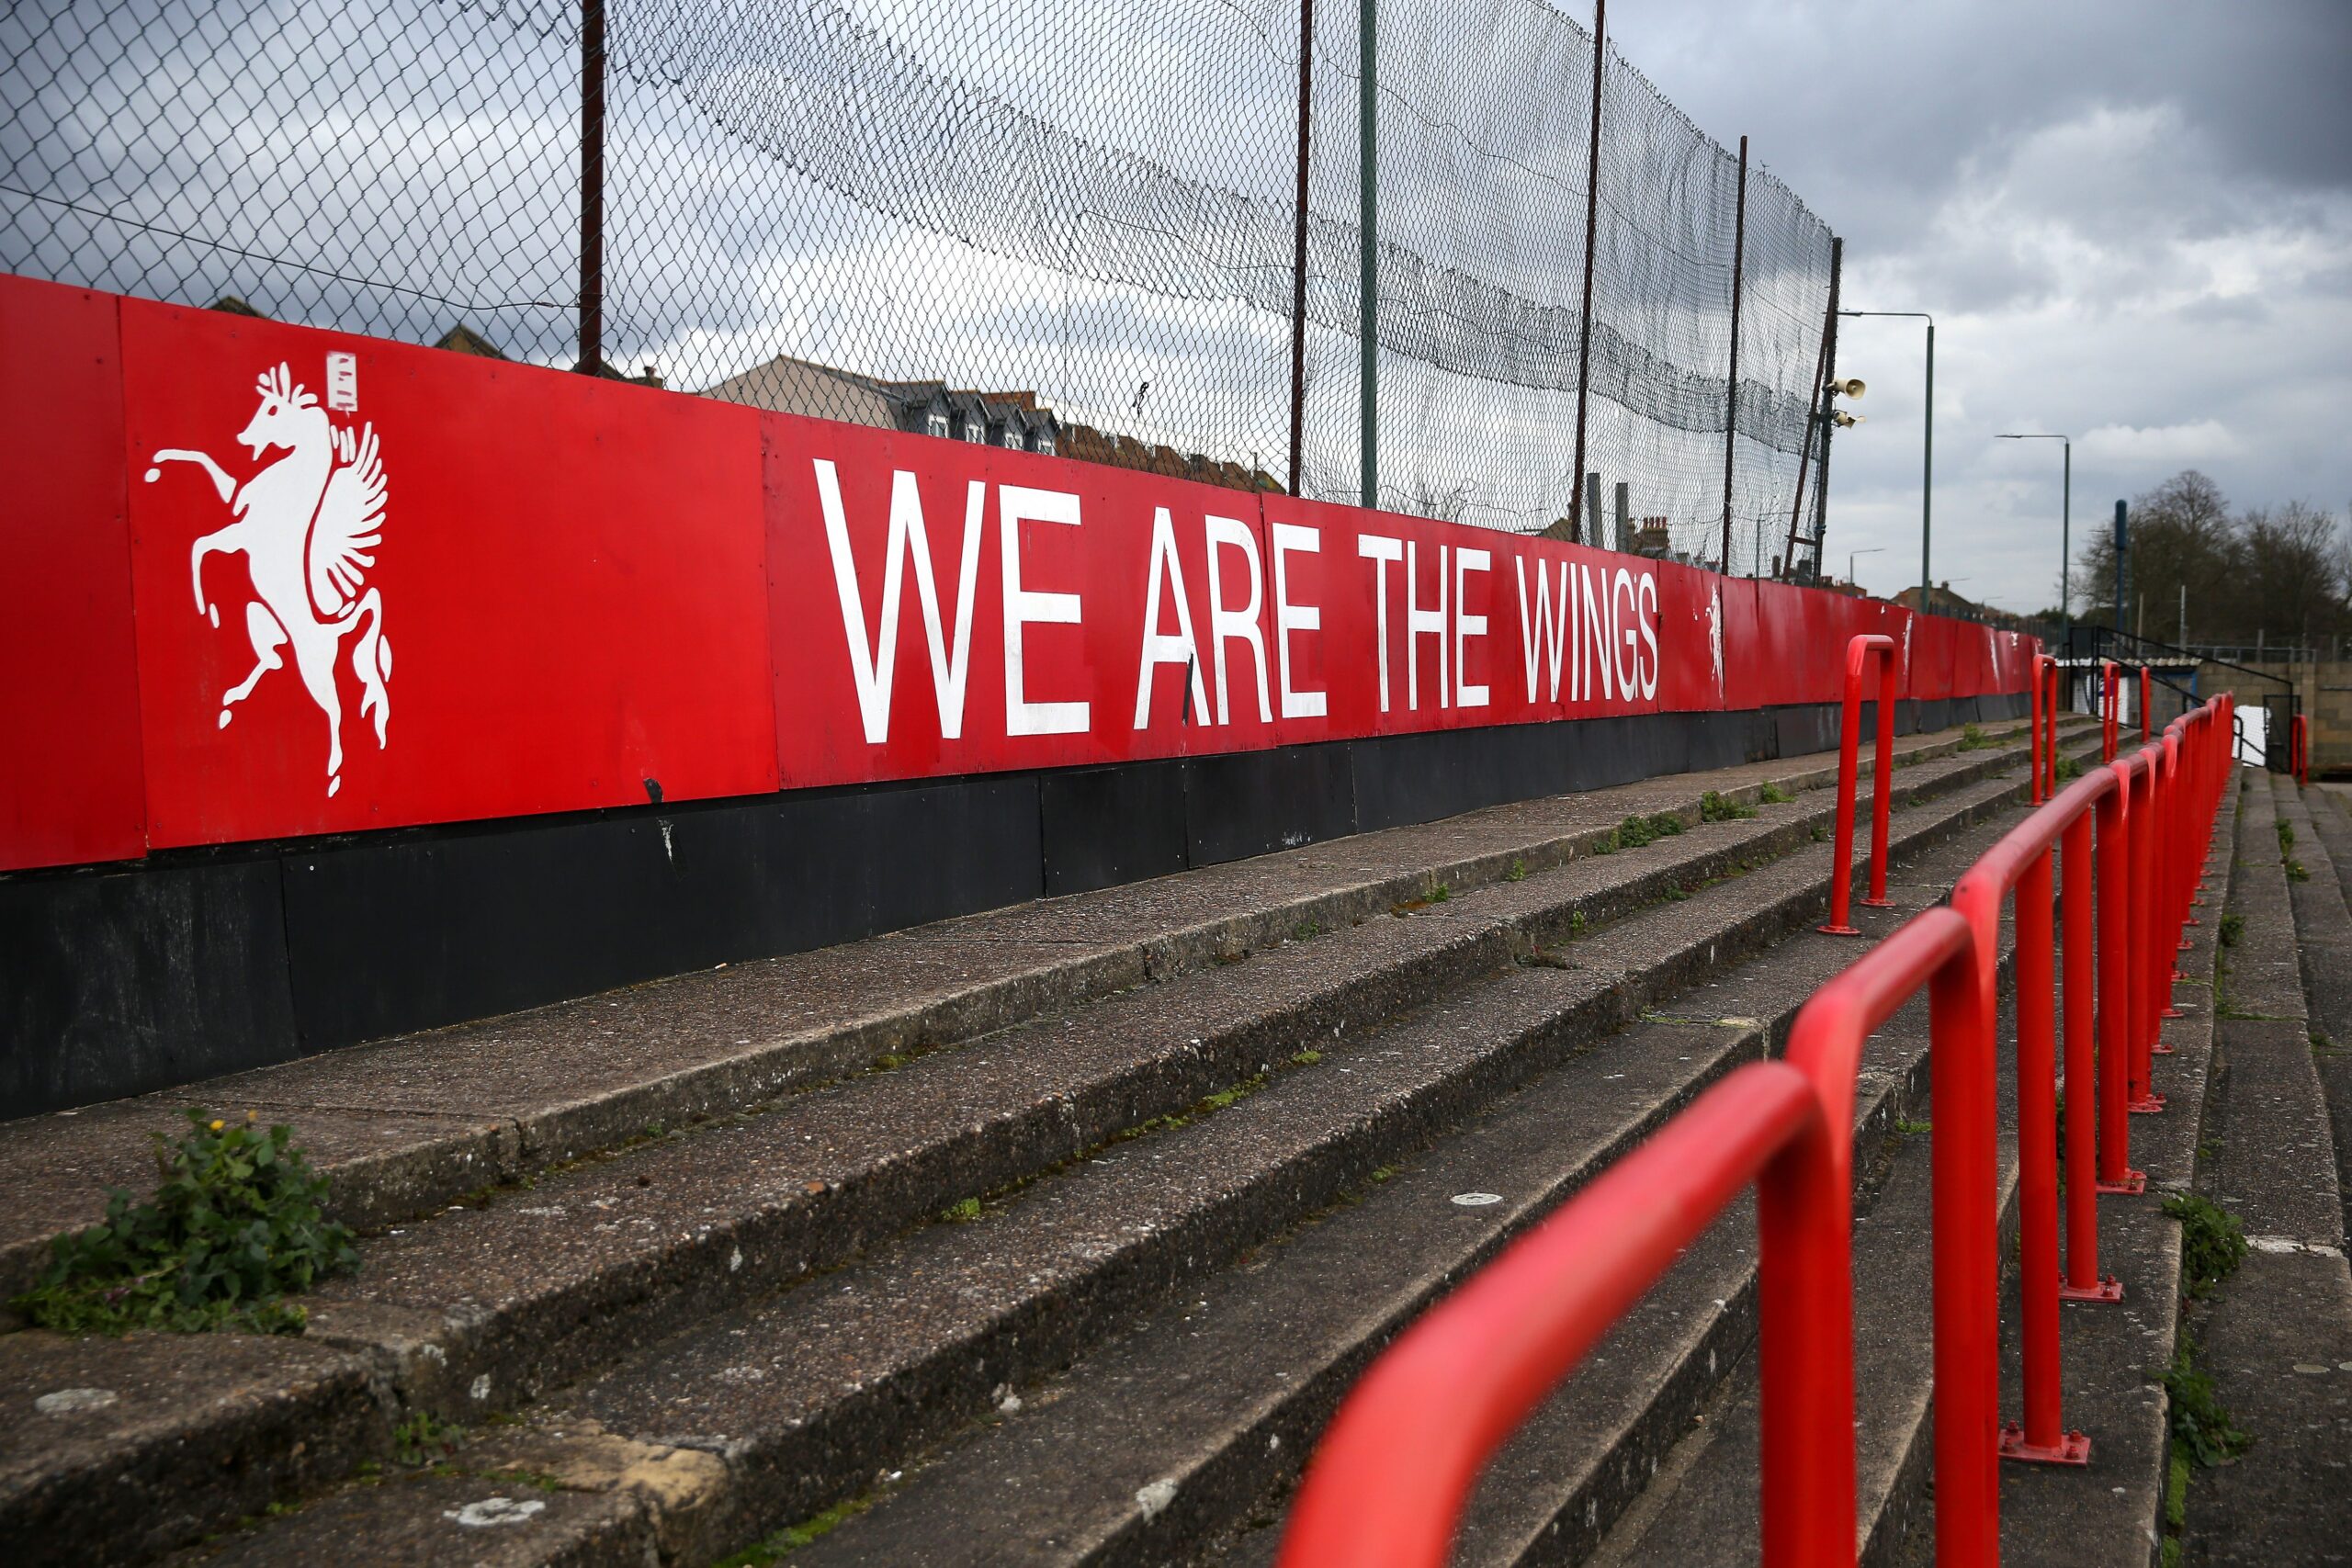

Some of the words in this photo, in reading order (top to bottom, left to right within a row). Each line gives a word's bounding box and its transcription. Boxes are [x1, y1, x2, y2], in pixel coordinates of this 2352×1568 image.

[813, 458, 1091, 744] WE
[1133, 506, 1328, 730] ARE
[1357, 533, 1491, 713] THE
[1515, 554, 1658, 704] WINGS
